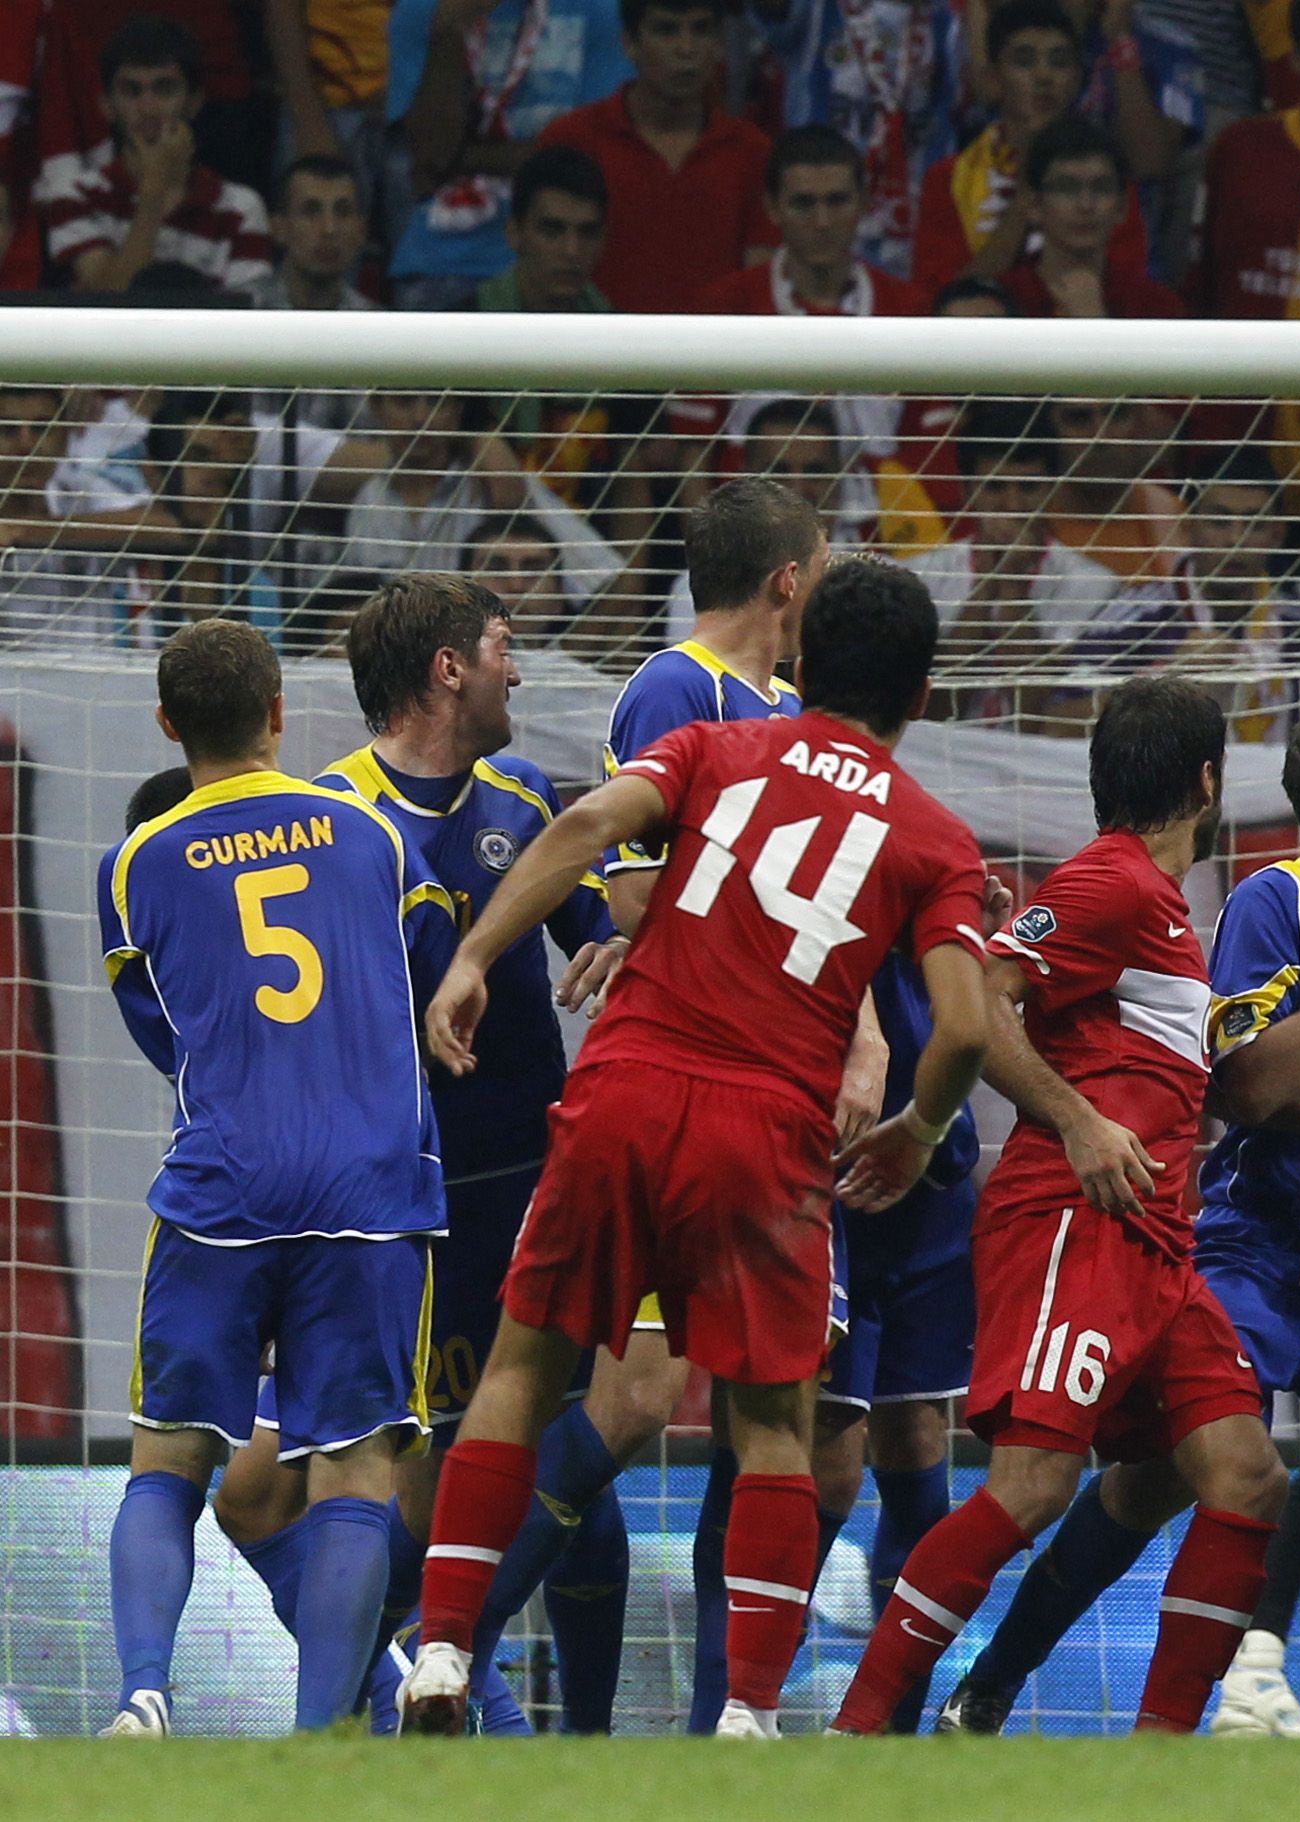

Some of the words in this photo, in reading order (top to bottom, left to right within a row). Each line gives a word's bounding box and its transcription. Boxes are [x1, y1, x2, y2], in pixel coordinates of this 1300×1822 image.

[779, 740, 892, 806] ARDA
[185, 815, 335, 870] GURMAN
[674, 775, 892, 986] 14
[234, 862, 325, 1025] 5
[1037, 1320, 1112, 1408] 16
